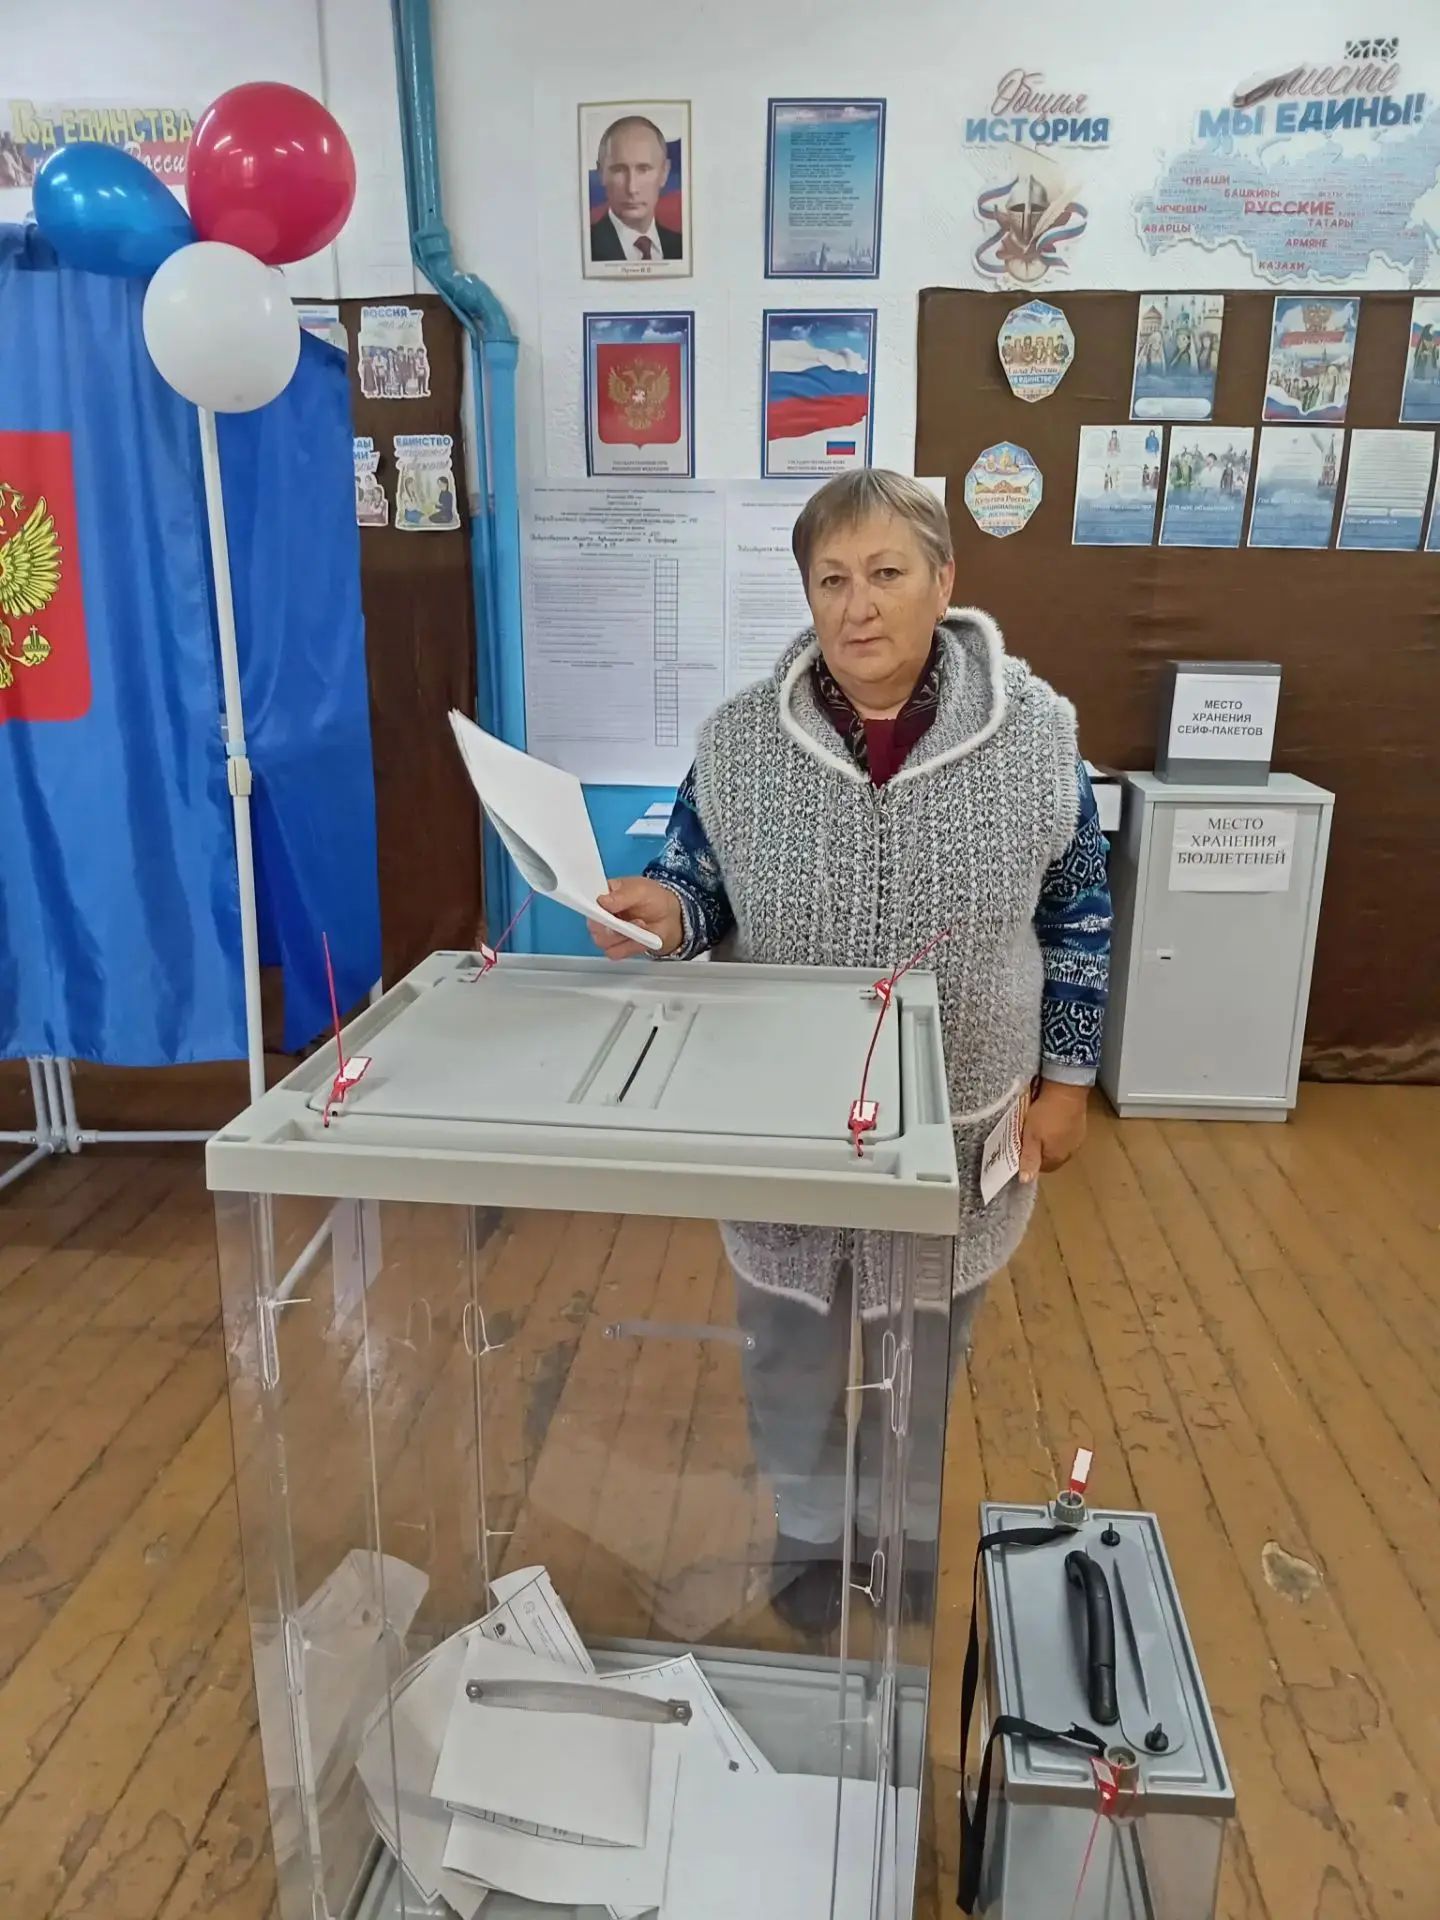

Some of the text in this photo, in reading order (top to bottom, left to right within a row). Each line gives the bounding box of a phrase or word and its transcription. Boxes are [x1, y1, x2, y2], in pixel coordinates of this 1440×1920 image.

[1199, 93, 1426, 138] МЫ ЕДИНЫ!
[10, 99, 193, 150] Год ЕДИНСТВА
[965, 117, 1110, 142] ИСТОРИЯ
[1224, 188, 1280, 198] БАШКИРЫ
[1244, 201, 1335, 216] РУССКИЕ
[1143, 223, 1191, 233] АВАРЦЫ
[1307, 218, 1354, 228] ТАТАРЫ
[1285, 238, 1328, 248] АРМЯНЕ
[1258, 261, 1306, 271] КАЗАХИ
[396, 437, 451, 447] ЕДИНСТВО
[1204, 700, 1243, 710] МЕСТО
[1192, 712, 1252, 723] ХРАНЕНИЯ
[1177, 724, 1263, 736] СЕЙФ-ПАКЕТОВ
[1207, 817, 1264, 830] МЕСТО
[1190, 834, 1276, 847] ХРАНЕНИЯ
[1177, 850, 1286, 865] БЮЛЛЕТЕНЕЙ
